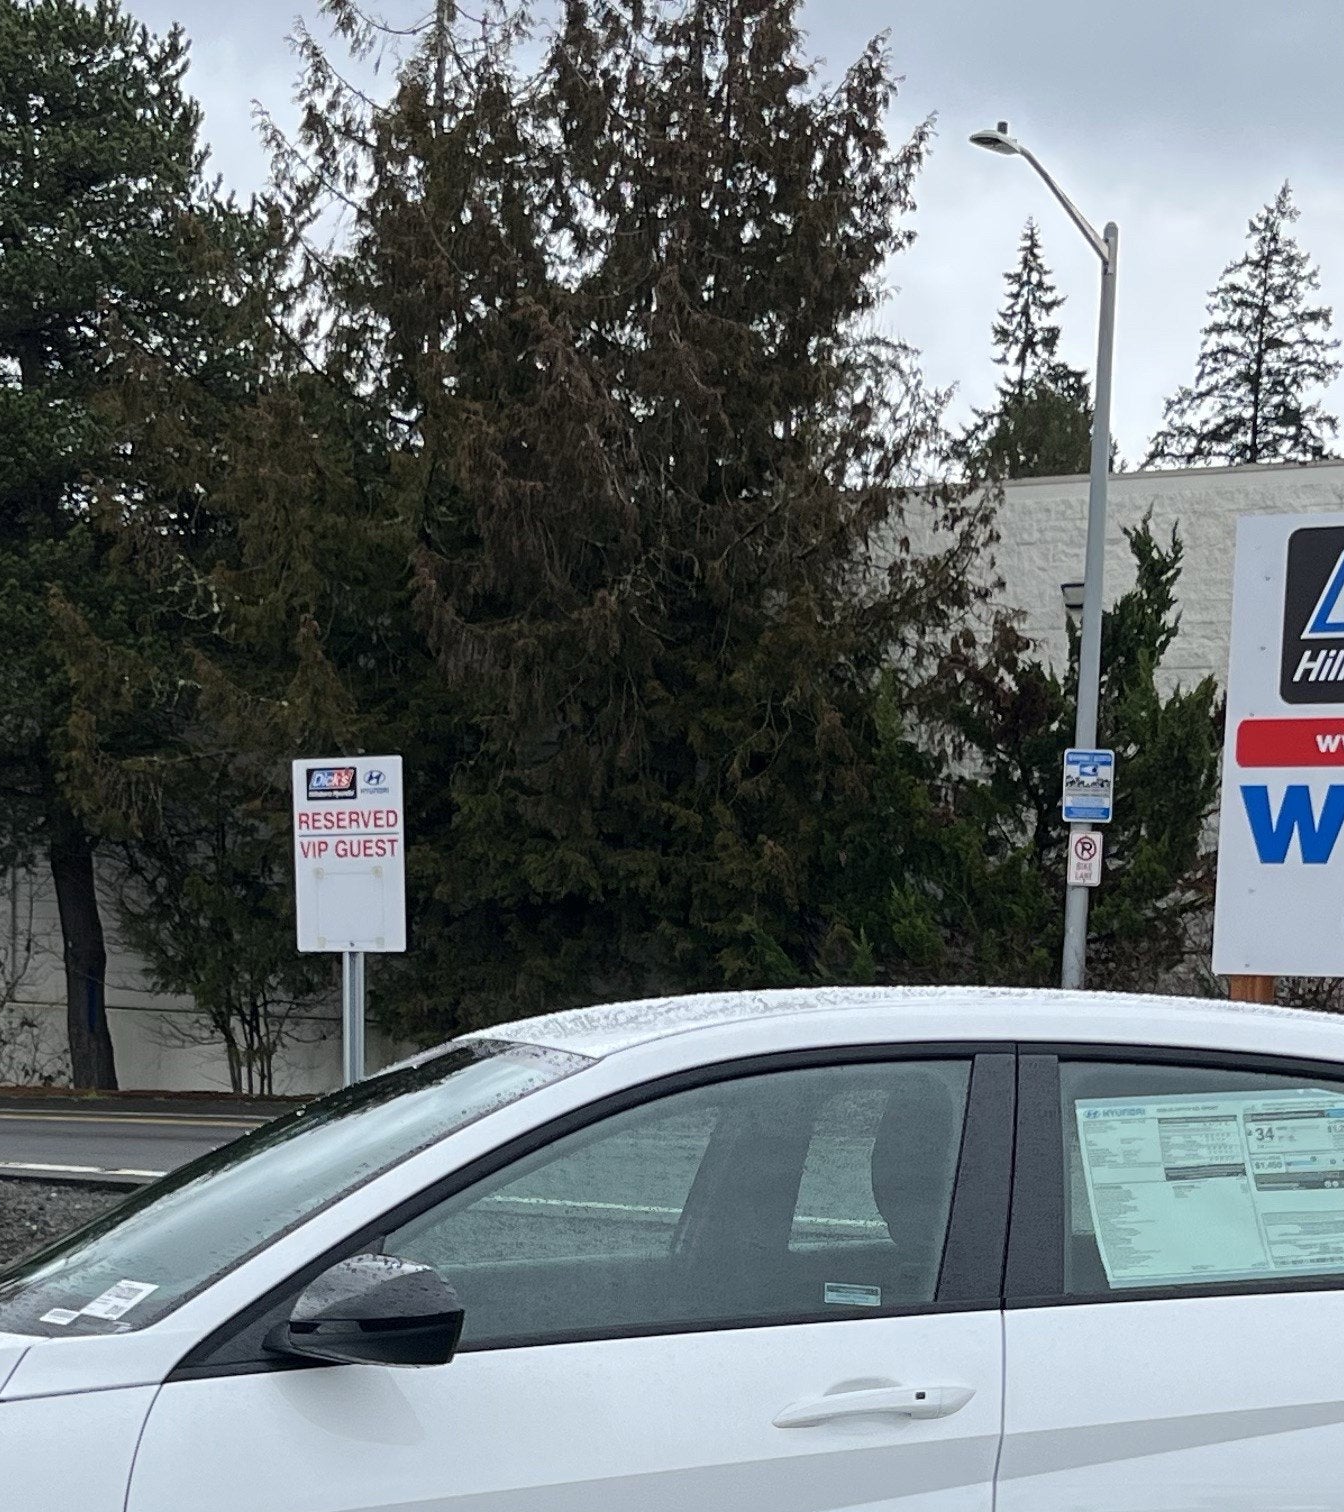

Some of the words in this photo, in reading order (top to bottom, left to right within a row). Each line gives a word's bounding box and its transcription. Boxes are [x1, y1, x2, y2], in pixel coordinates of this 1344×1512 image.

[298, 809, 398, 830] RESERVED
[299, 840, 329, 859] VIP
[334, 839, 399, 859] GUEST
[1255, 1127, 1275, 1141] 34
